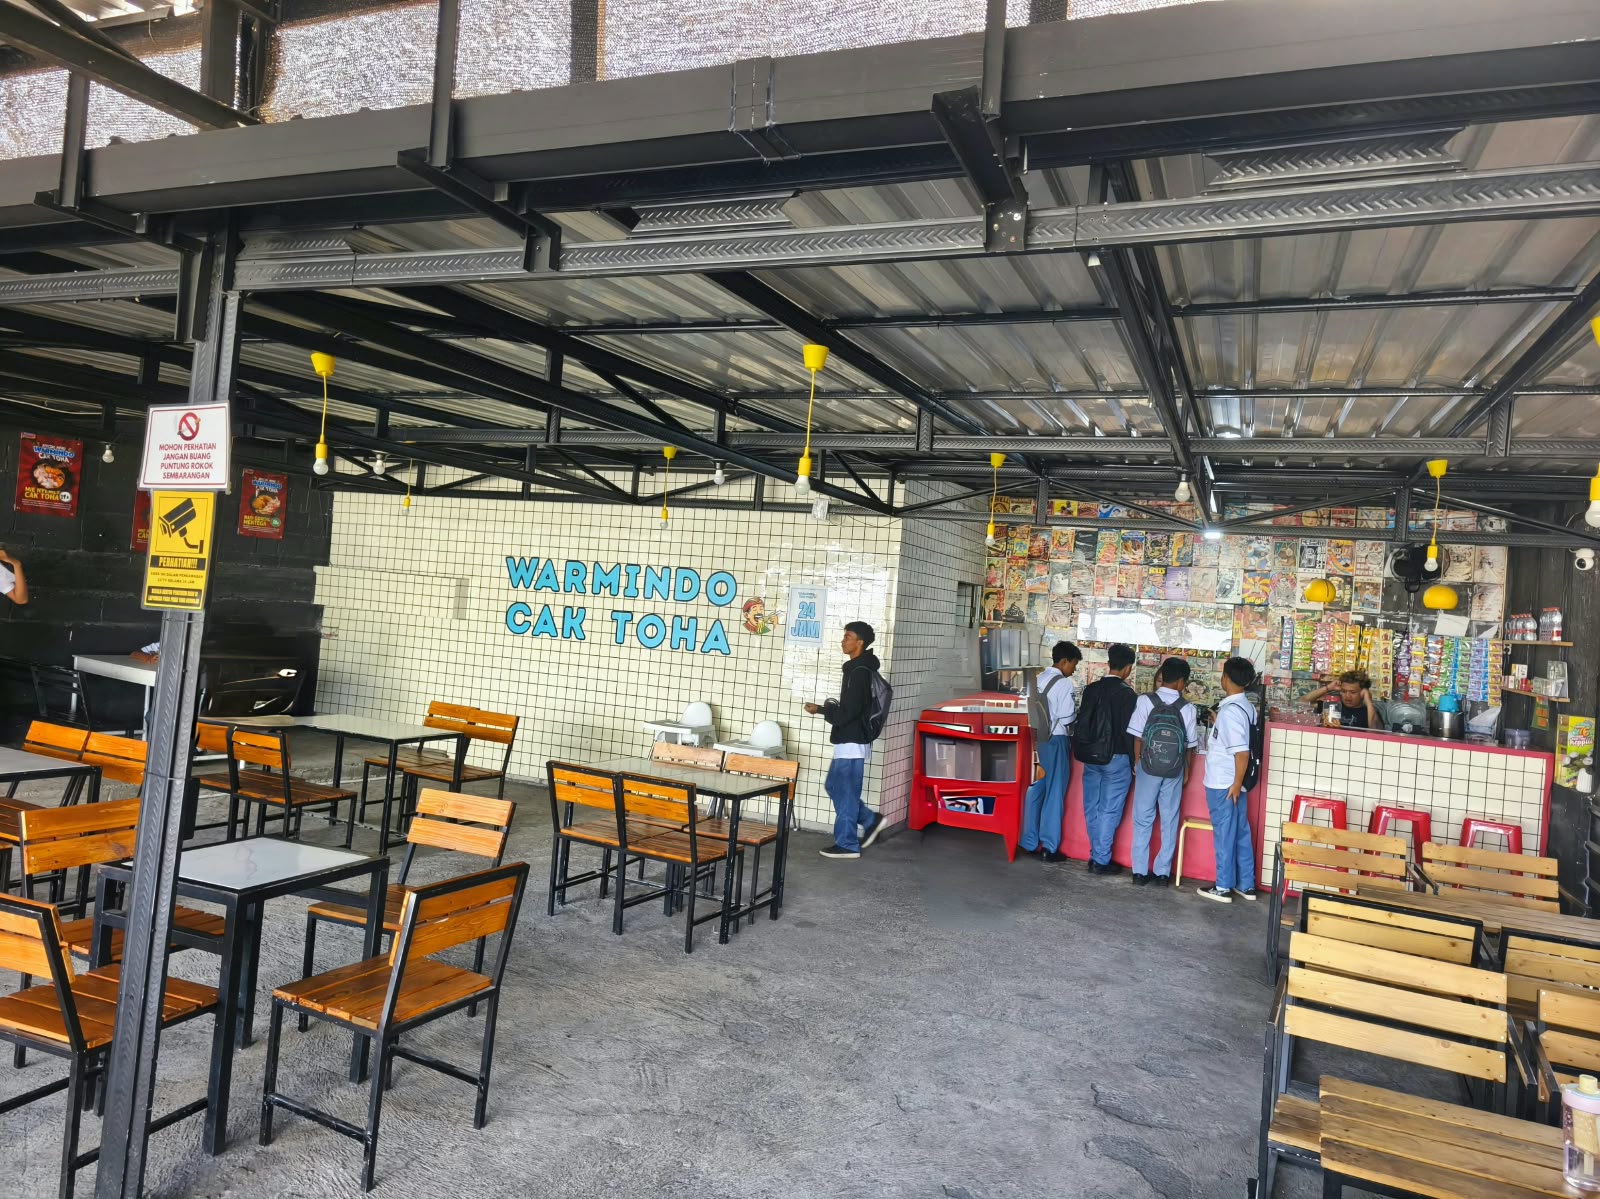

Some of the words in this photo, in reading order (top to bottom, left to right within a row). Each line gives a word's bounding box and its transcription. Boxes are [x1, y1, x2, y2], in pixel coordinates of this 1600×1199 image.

[159, 443, 183, 451] MOHON
[506, 556, 737, 607] WARMINDO
[798, 601, 816, 619] 24
[505, 602, 586, 640] CAK
[611, 610, 731, 655] TOHA
[791, 619, 820, 639] JAM
